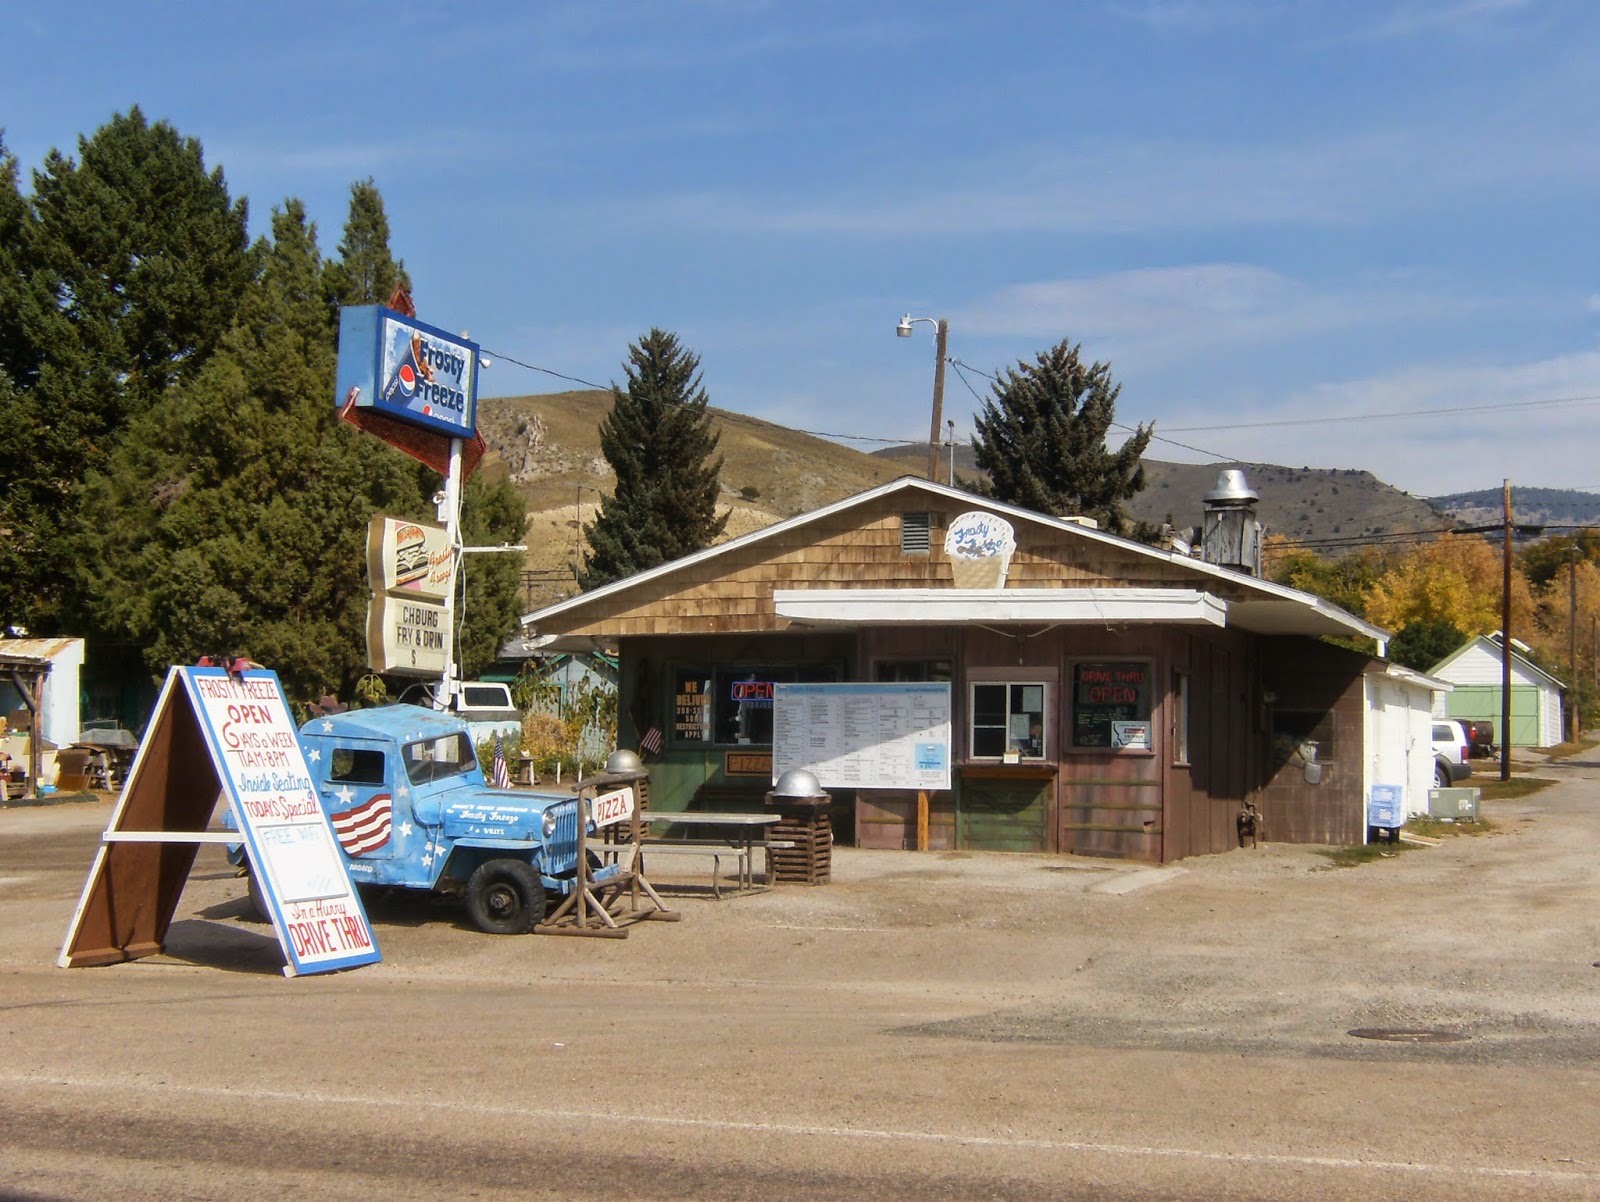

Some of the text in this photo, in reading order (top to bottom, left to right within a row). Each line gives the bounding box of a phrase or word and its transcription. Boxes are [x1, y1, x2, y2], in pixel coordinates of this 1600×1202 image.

[420, 339, 465, 384] Frosty
[415, 373, 464, 413] Freeze
[953, 521, 990, 544] Frosty
[402, 606, 439, 628] CHBURG
[396, 626, 444, 649] FRY & DRIN
[411, 649, 417, 665] S
[198, 678, 279, 700] FROSTY FREEZE
[733, 682, 775, 699] OPEN
[1089, 685, 1137, 704] OPEN
[227, 704, 273, 724] OPEN
[240, 731, 261, 749] AYS
[266, 732, 296, 748] WEEK
[272, 771, 314, 800] Seating
[281, 791, 320, 822] Special
[597, 794, 628, 823] PIZZA
[315, 900, 348, 918] Hurry
[288, 914, 371, 957] DRIVE THRU
